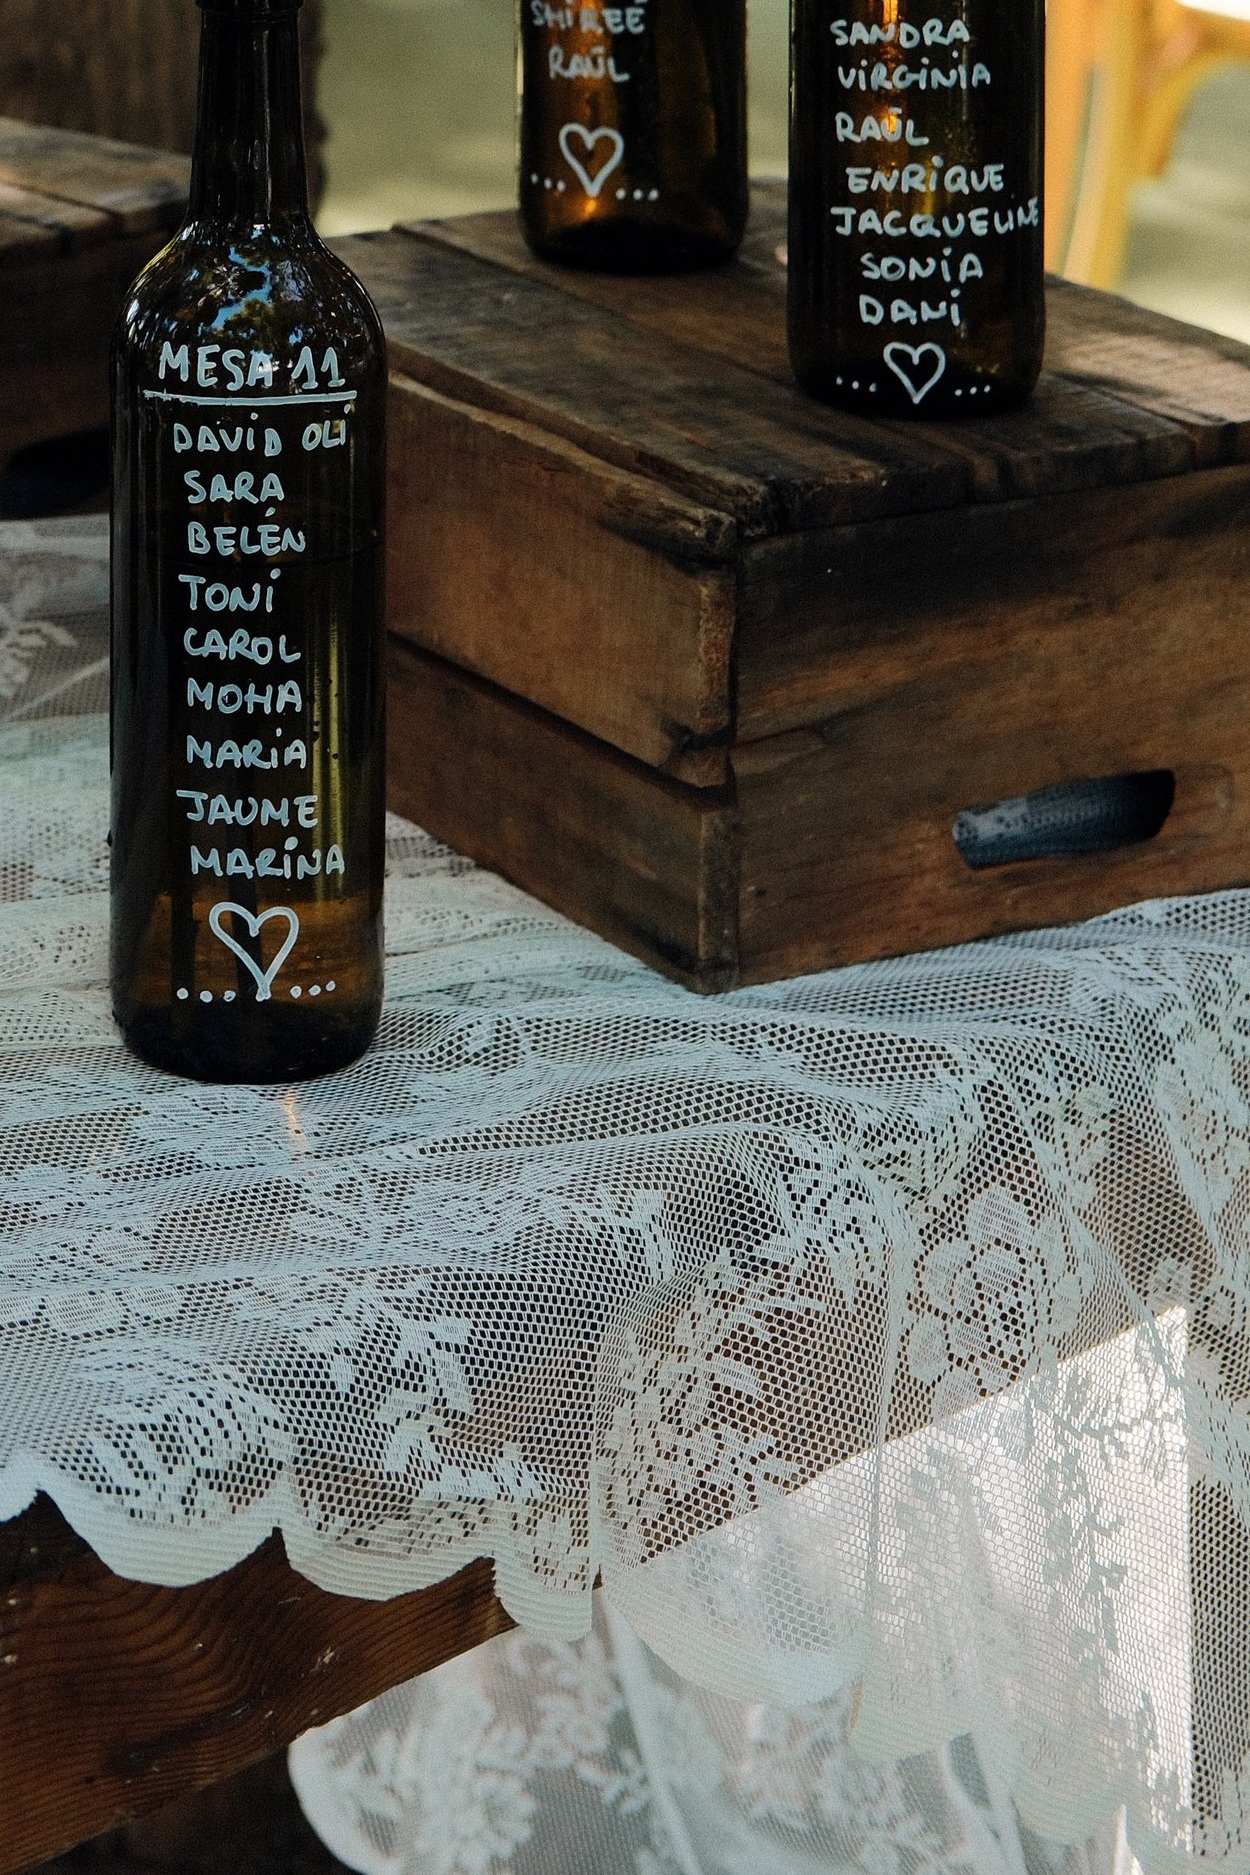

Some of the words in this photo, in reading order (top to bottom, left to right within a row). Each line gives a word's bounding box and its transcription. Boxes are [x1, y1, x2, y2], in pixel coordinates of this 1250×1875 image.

[830, 18, 970, 49] SANDRA
[837, 50, 991, 91] ViRGiNiA
[846, 155, 1004, 195] ENRiQUE
[860, 246, 983, 283] SONiA
[859, 288, 961, 326] DANi
[158, 341, 273, 390] MESA
[291, 346, 346, 389] 11
[173, 412, 282, 457] DAViD
[302, 403, 351, 451] OLi
[184, 470, 285, 504] SARA
[187, 507, 306, 556] BELÉN
[178, 568, 281, 613] TONi
[183, 628, 301, 665] CAROL
[187, 677, 302, 714] MOHA
[186, 727, 307, 769] MARiA
[176, 790, 318, 828] JAUME
[190, 836, 345, 879] MARiNA
